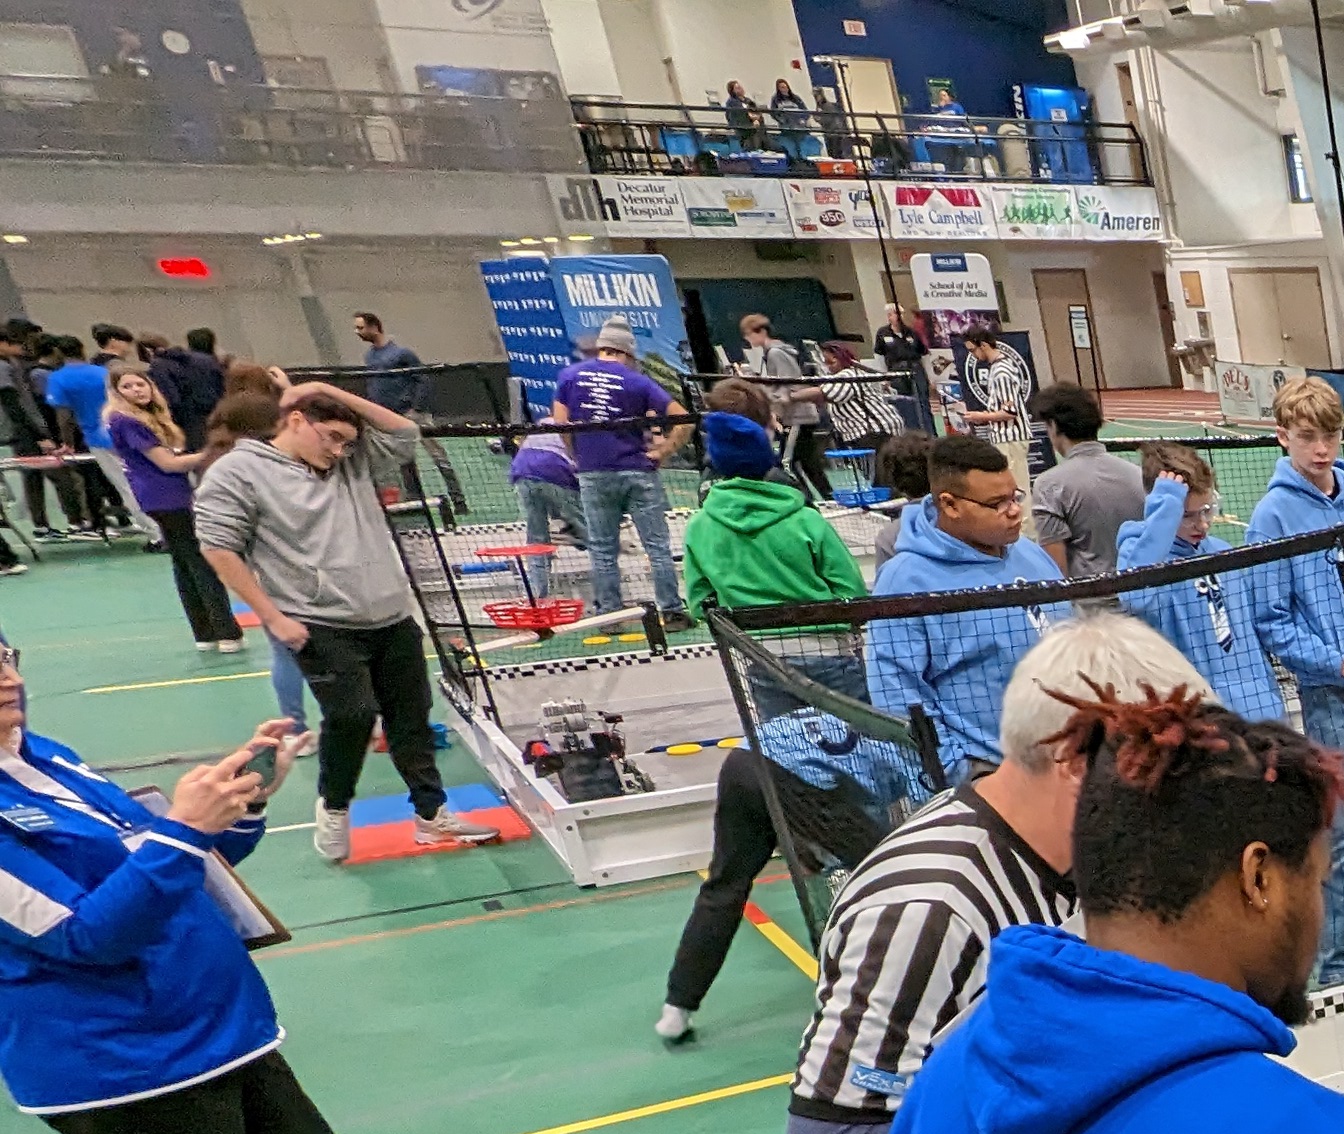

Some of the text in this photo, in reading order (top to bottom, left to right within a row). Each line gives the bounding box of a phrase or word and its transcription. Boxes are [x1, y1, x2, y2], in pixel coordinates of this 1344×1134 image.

[617, 181, 666, 193] Decatur
[620, 193, 679, 206] Memorial
[623, 205, 674, 218] Hospital
[898, 208, 984, 229] Lyle Campbell
[1100, 212, 1160, 231] Ameren
[562, 273, 663, 308] MILLIKIN
[929, 281, 955, 290] School
[579, 310, 660, 329] UNISITY
